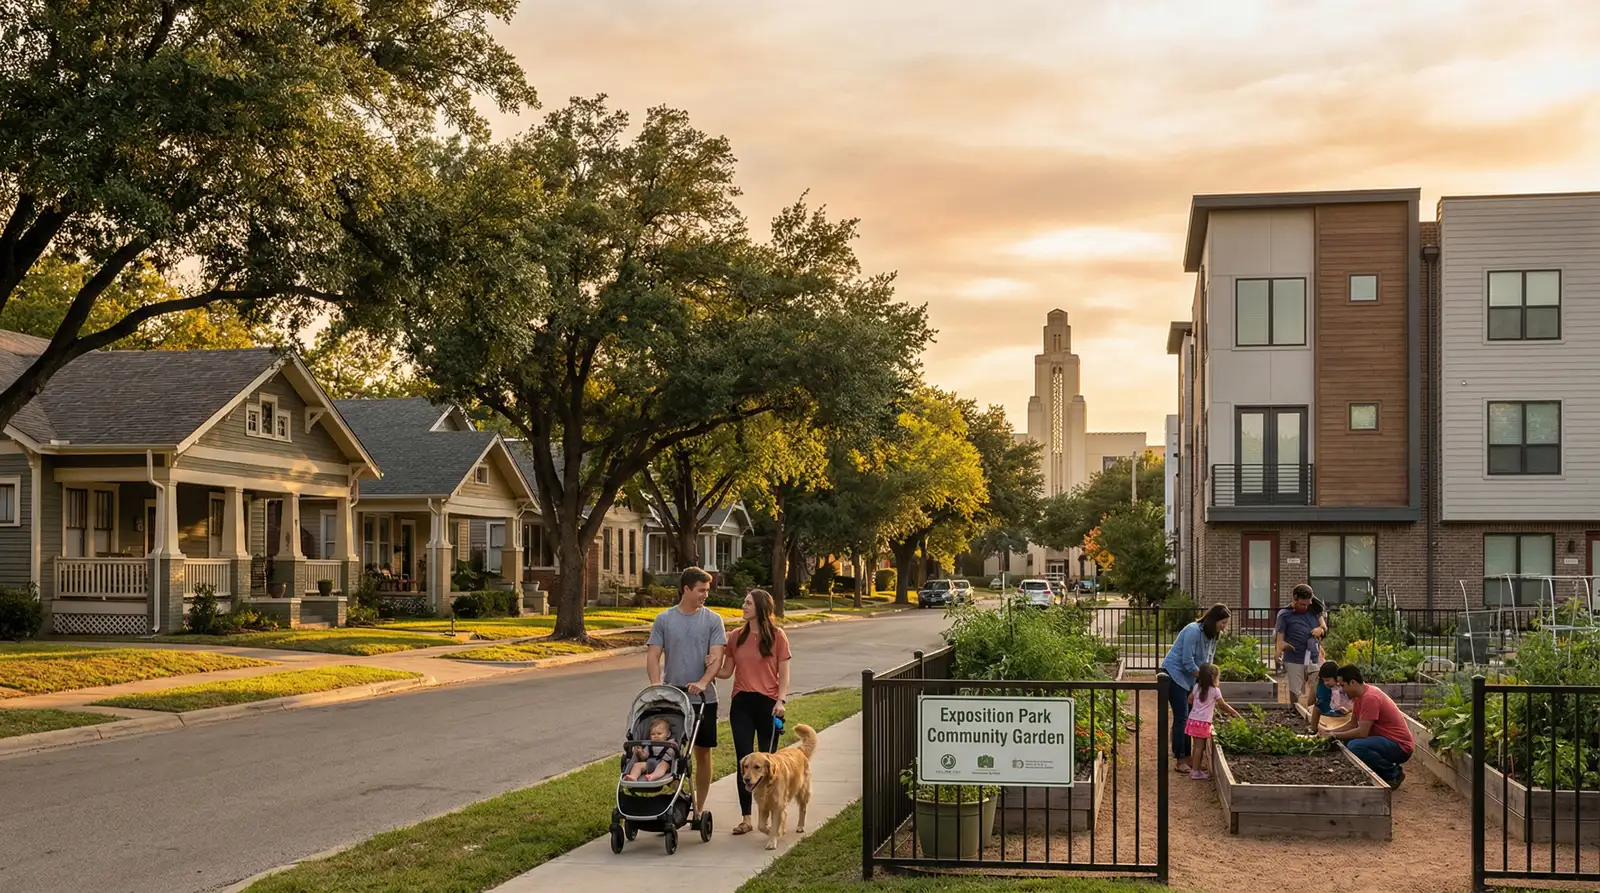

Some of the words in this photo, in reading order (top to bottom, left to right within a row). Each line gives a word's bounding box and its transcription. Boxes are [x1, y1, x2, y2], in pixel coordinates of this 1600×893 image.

[940, 707, 1014, 726] Exposition
[1019, 708, 1052, 724] Park
[927, 727, 1008, 747] Community
[1013, 728, 1065, 745] Garden
